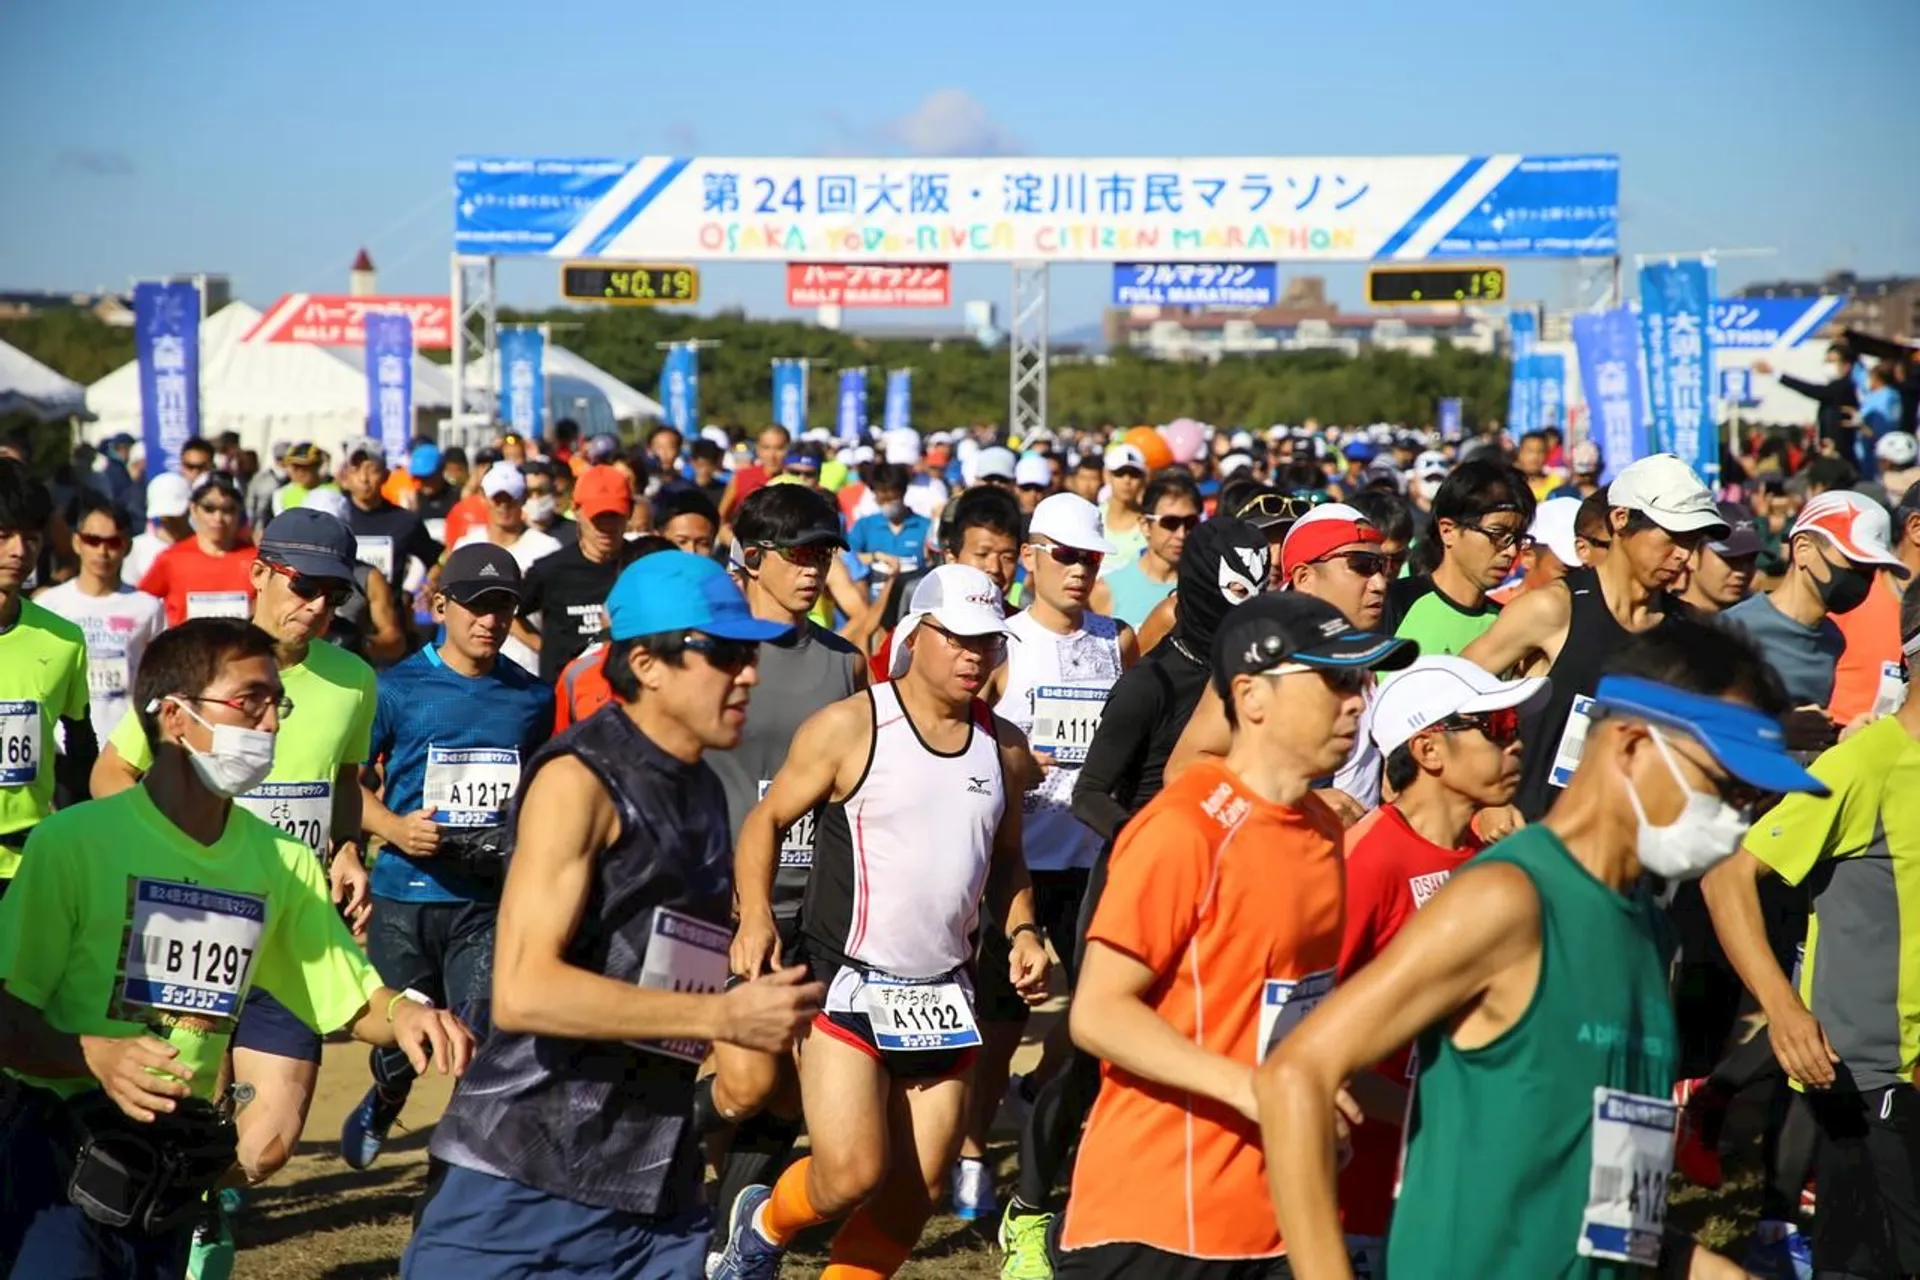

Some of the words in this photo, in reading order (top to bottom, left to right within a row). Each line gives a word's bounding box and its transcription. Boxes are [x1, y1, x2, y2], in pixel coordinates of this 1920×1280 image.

[700, 222, 806, 252] OSAKA
[1035, 224, 1158, 253] CITIZEN
[1173, 223, 1355, 250] MARATHON
[804, 265, 943, 286] ハーフマラソン
[1134, 264, 1256, 286] フルマラソン
[1119, 287, 1164, 303] FULL
[1167, 288, 1270, 303] MARATHON
[450, 783, 511, 806] A1217
[166, 940, 253, 986] B1297
[161, 984, 229, 1010] ダックツアー
[893, 1004, 963, 1030] A1122
